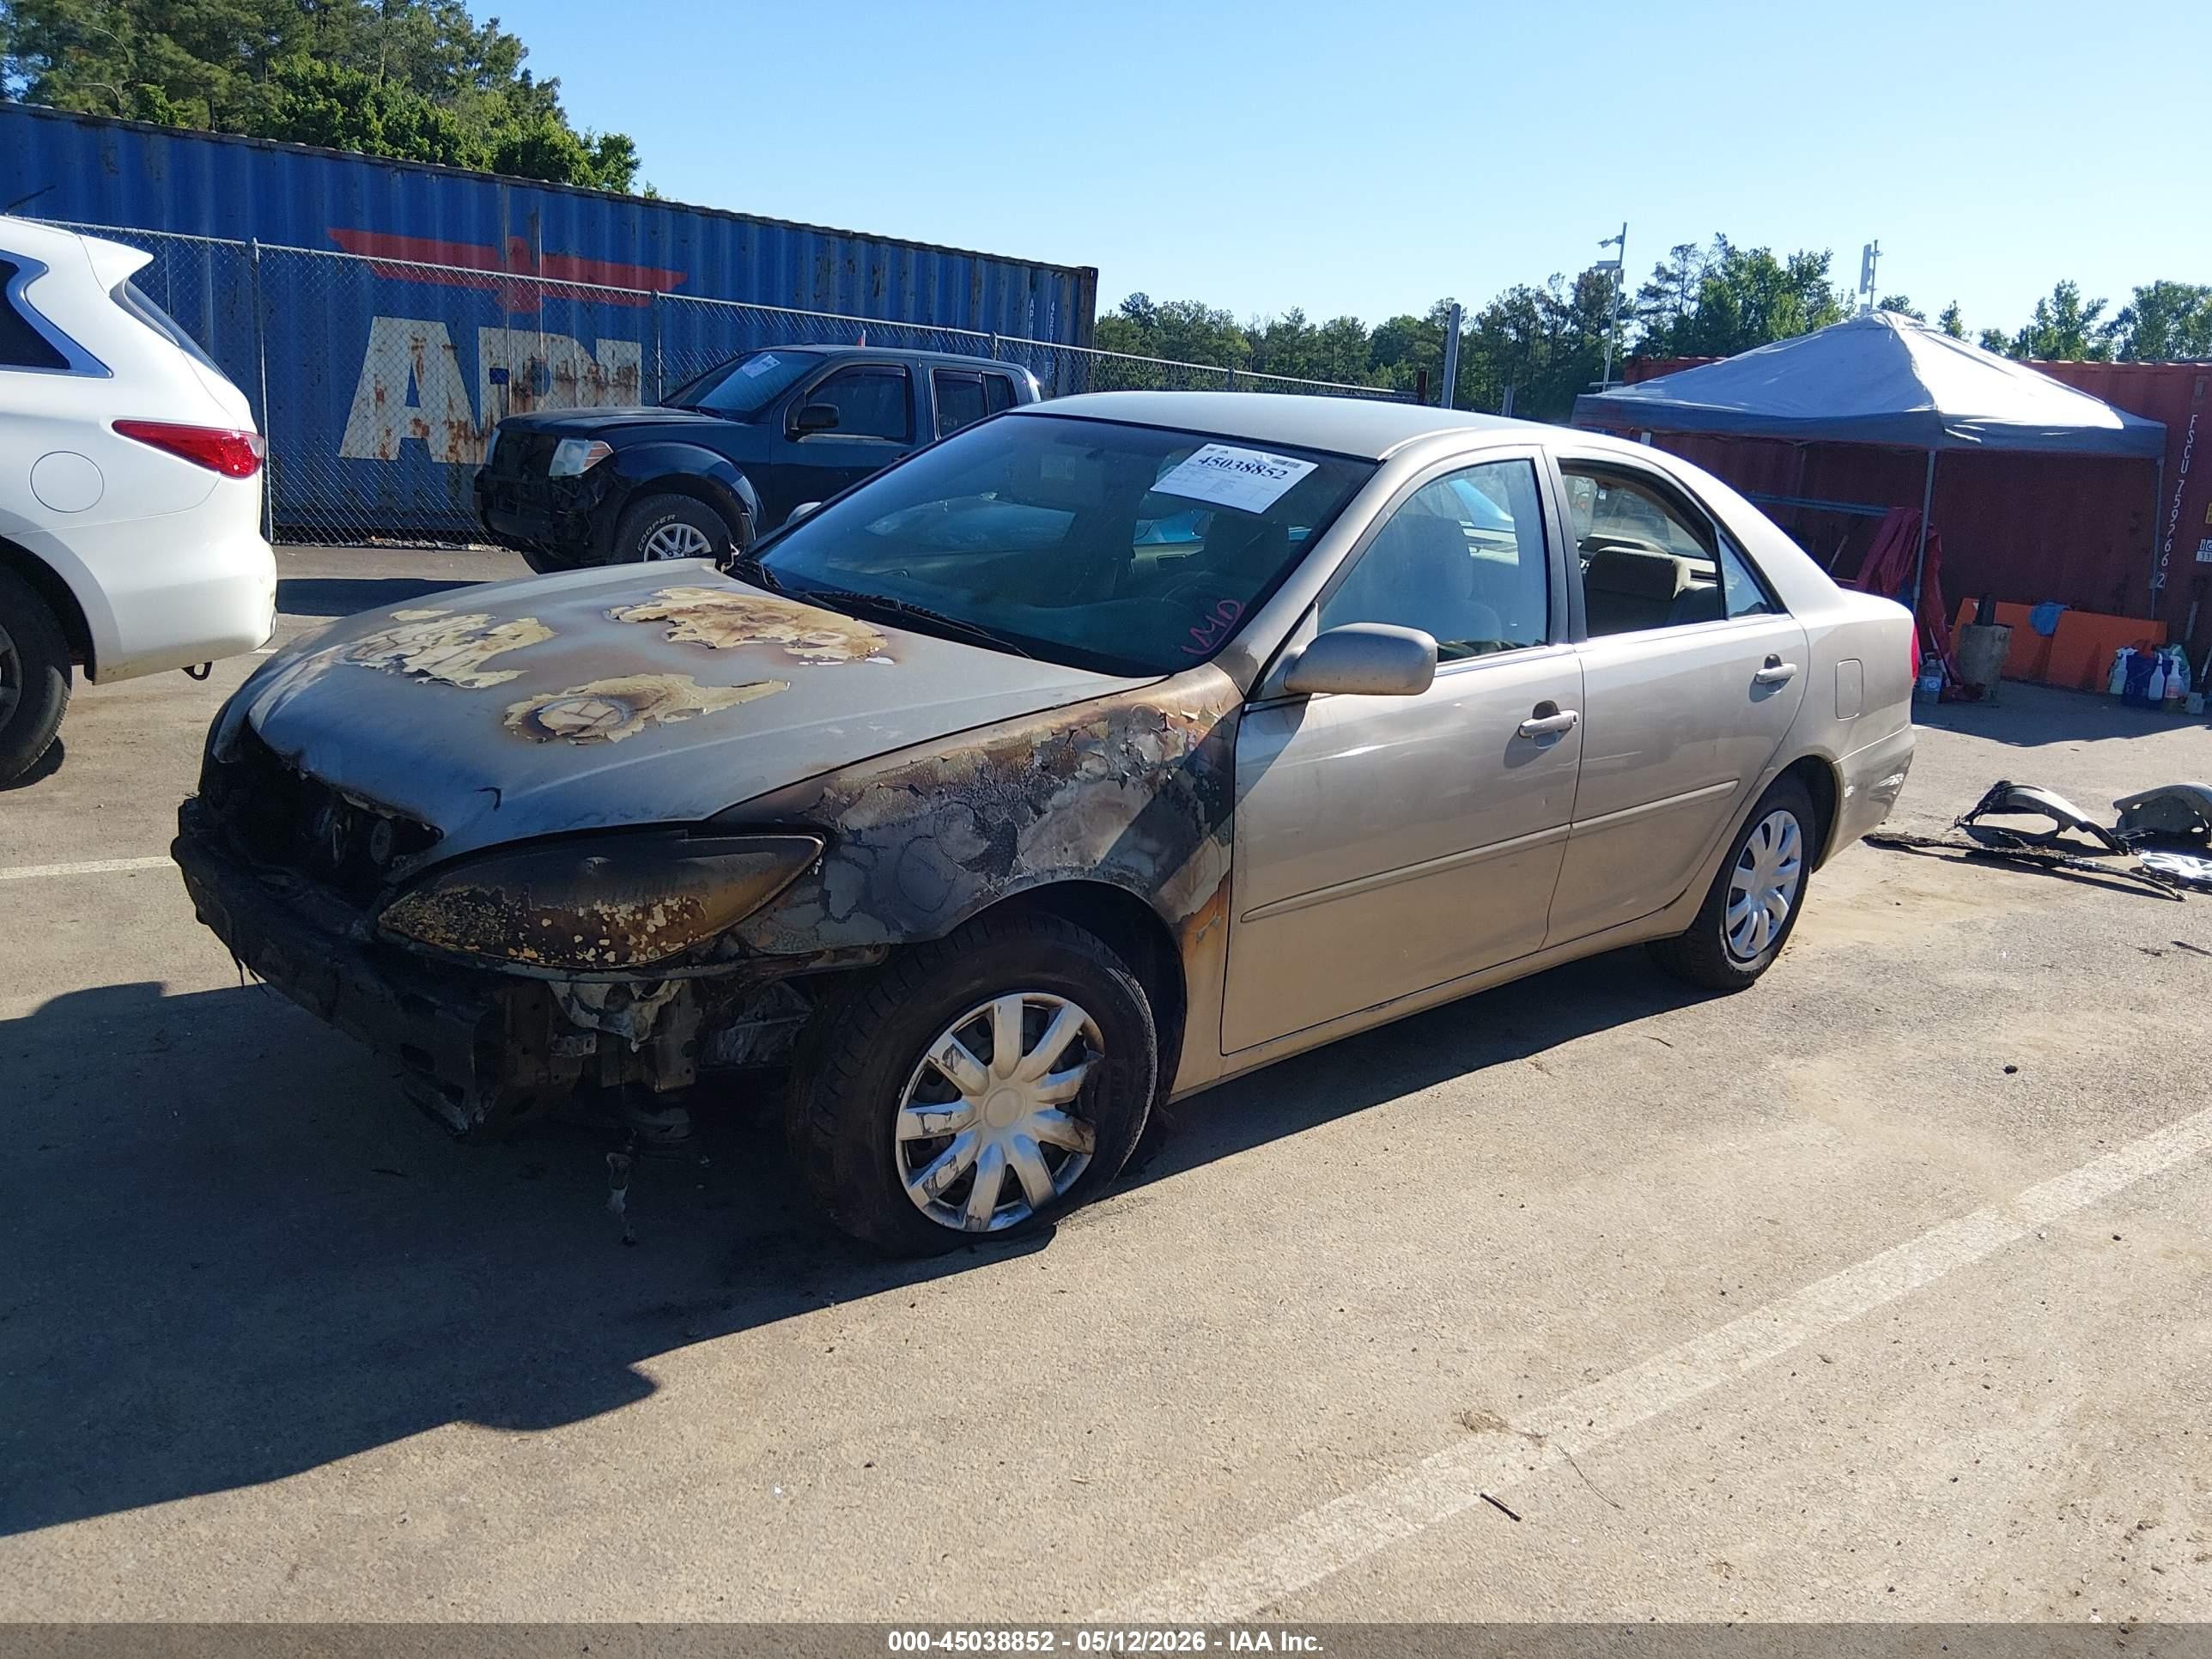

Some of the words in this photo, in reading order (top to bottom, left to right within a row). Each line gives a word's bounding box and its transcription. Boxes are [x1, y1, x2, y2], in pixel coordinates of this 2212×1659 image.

[2180, 414, 2198, 474] FSCU
[1198, 455, 1289, 479] 45038852
[637, 514, 677, 552] COOPER
